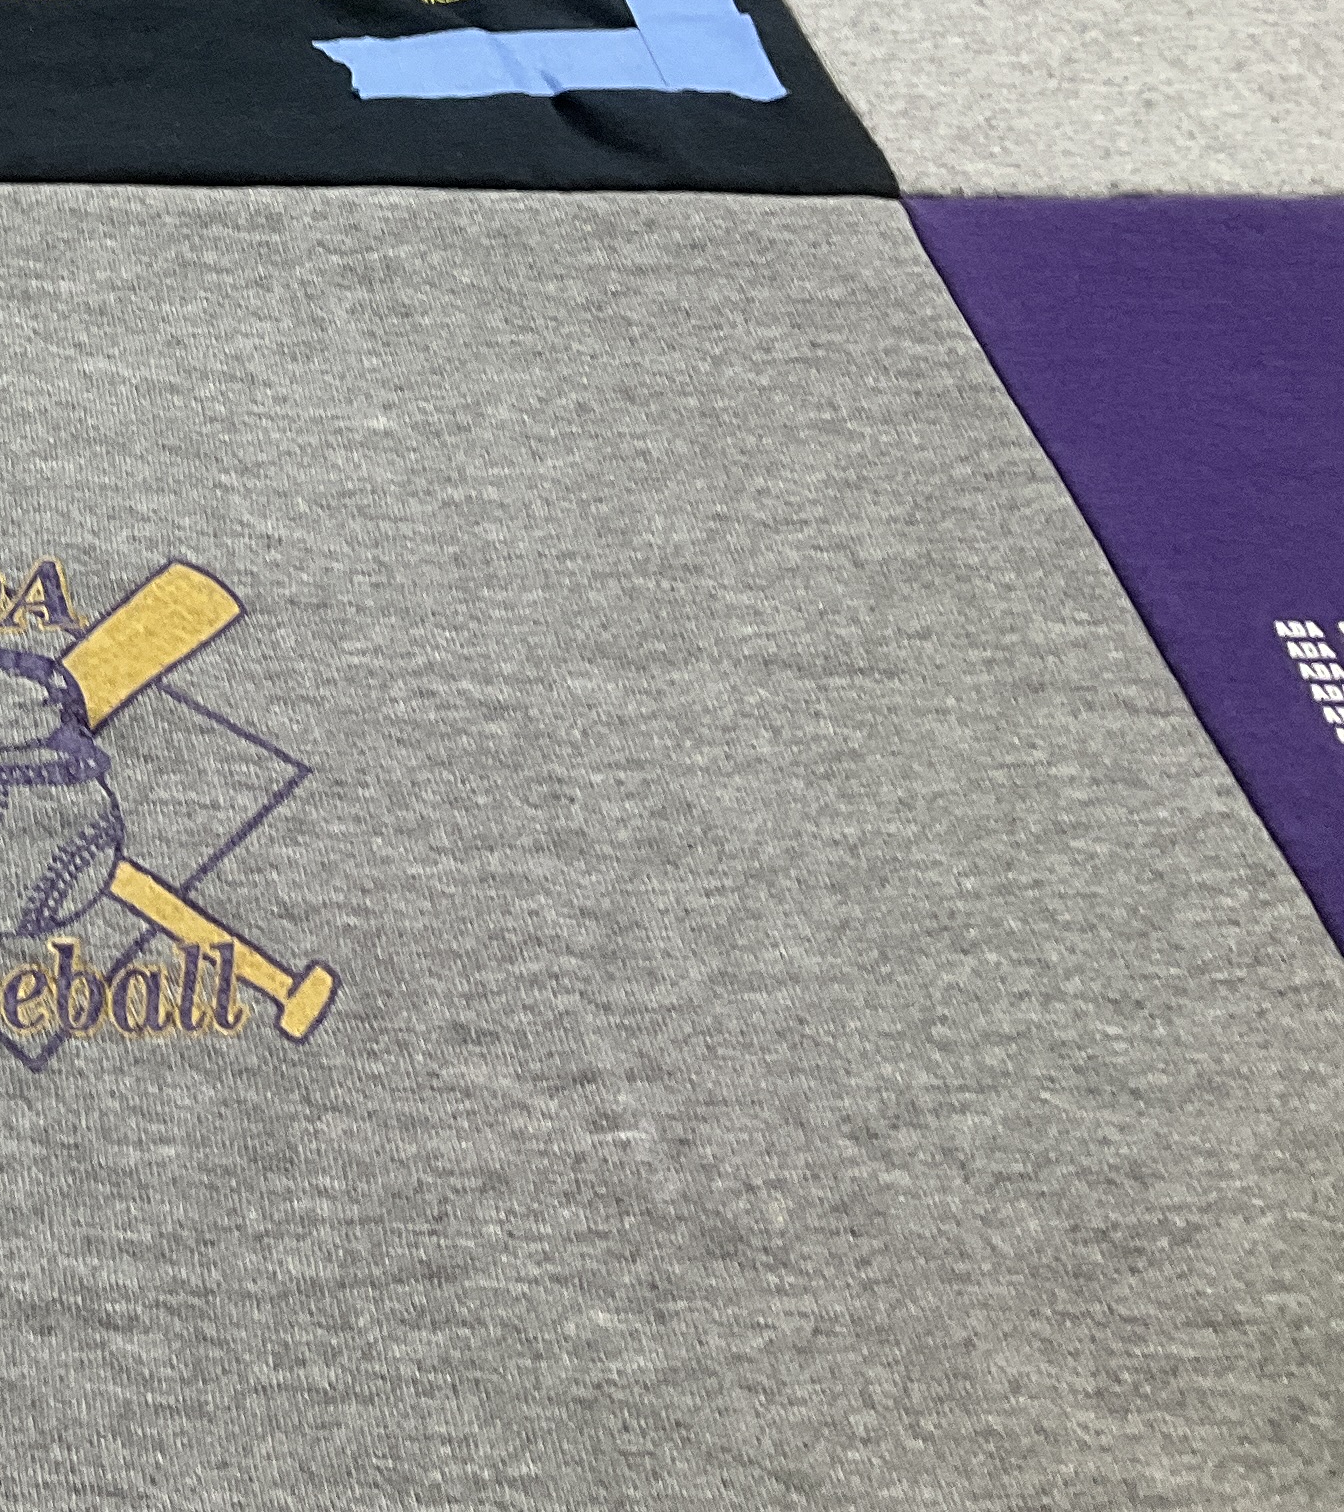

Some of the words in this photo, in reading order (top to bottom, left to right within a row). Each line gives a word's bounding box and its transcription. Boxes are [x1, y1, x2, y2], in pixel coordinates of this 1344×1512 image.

[1273, 620, 1325, 638] ADA
[1286, 640, 1337, 659] ADA
[1311, 683, 1344, 702] AD
